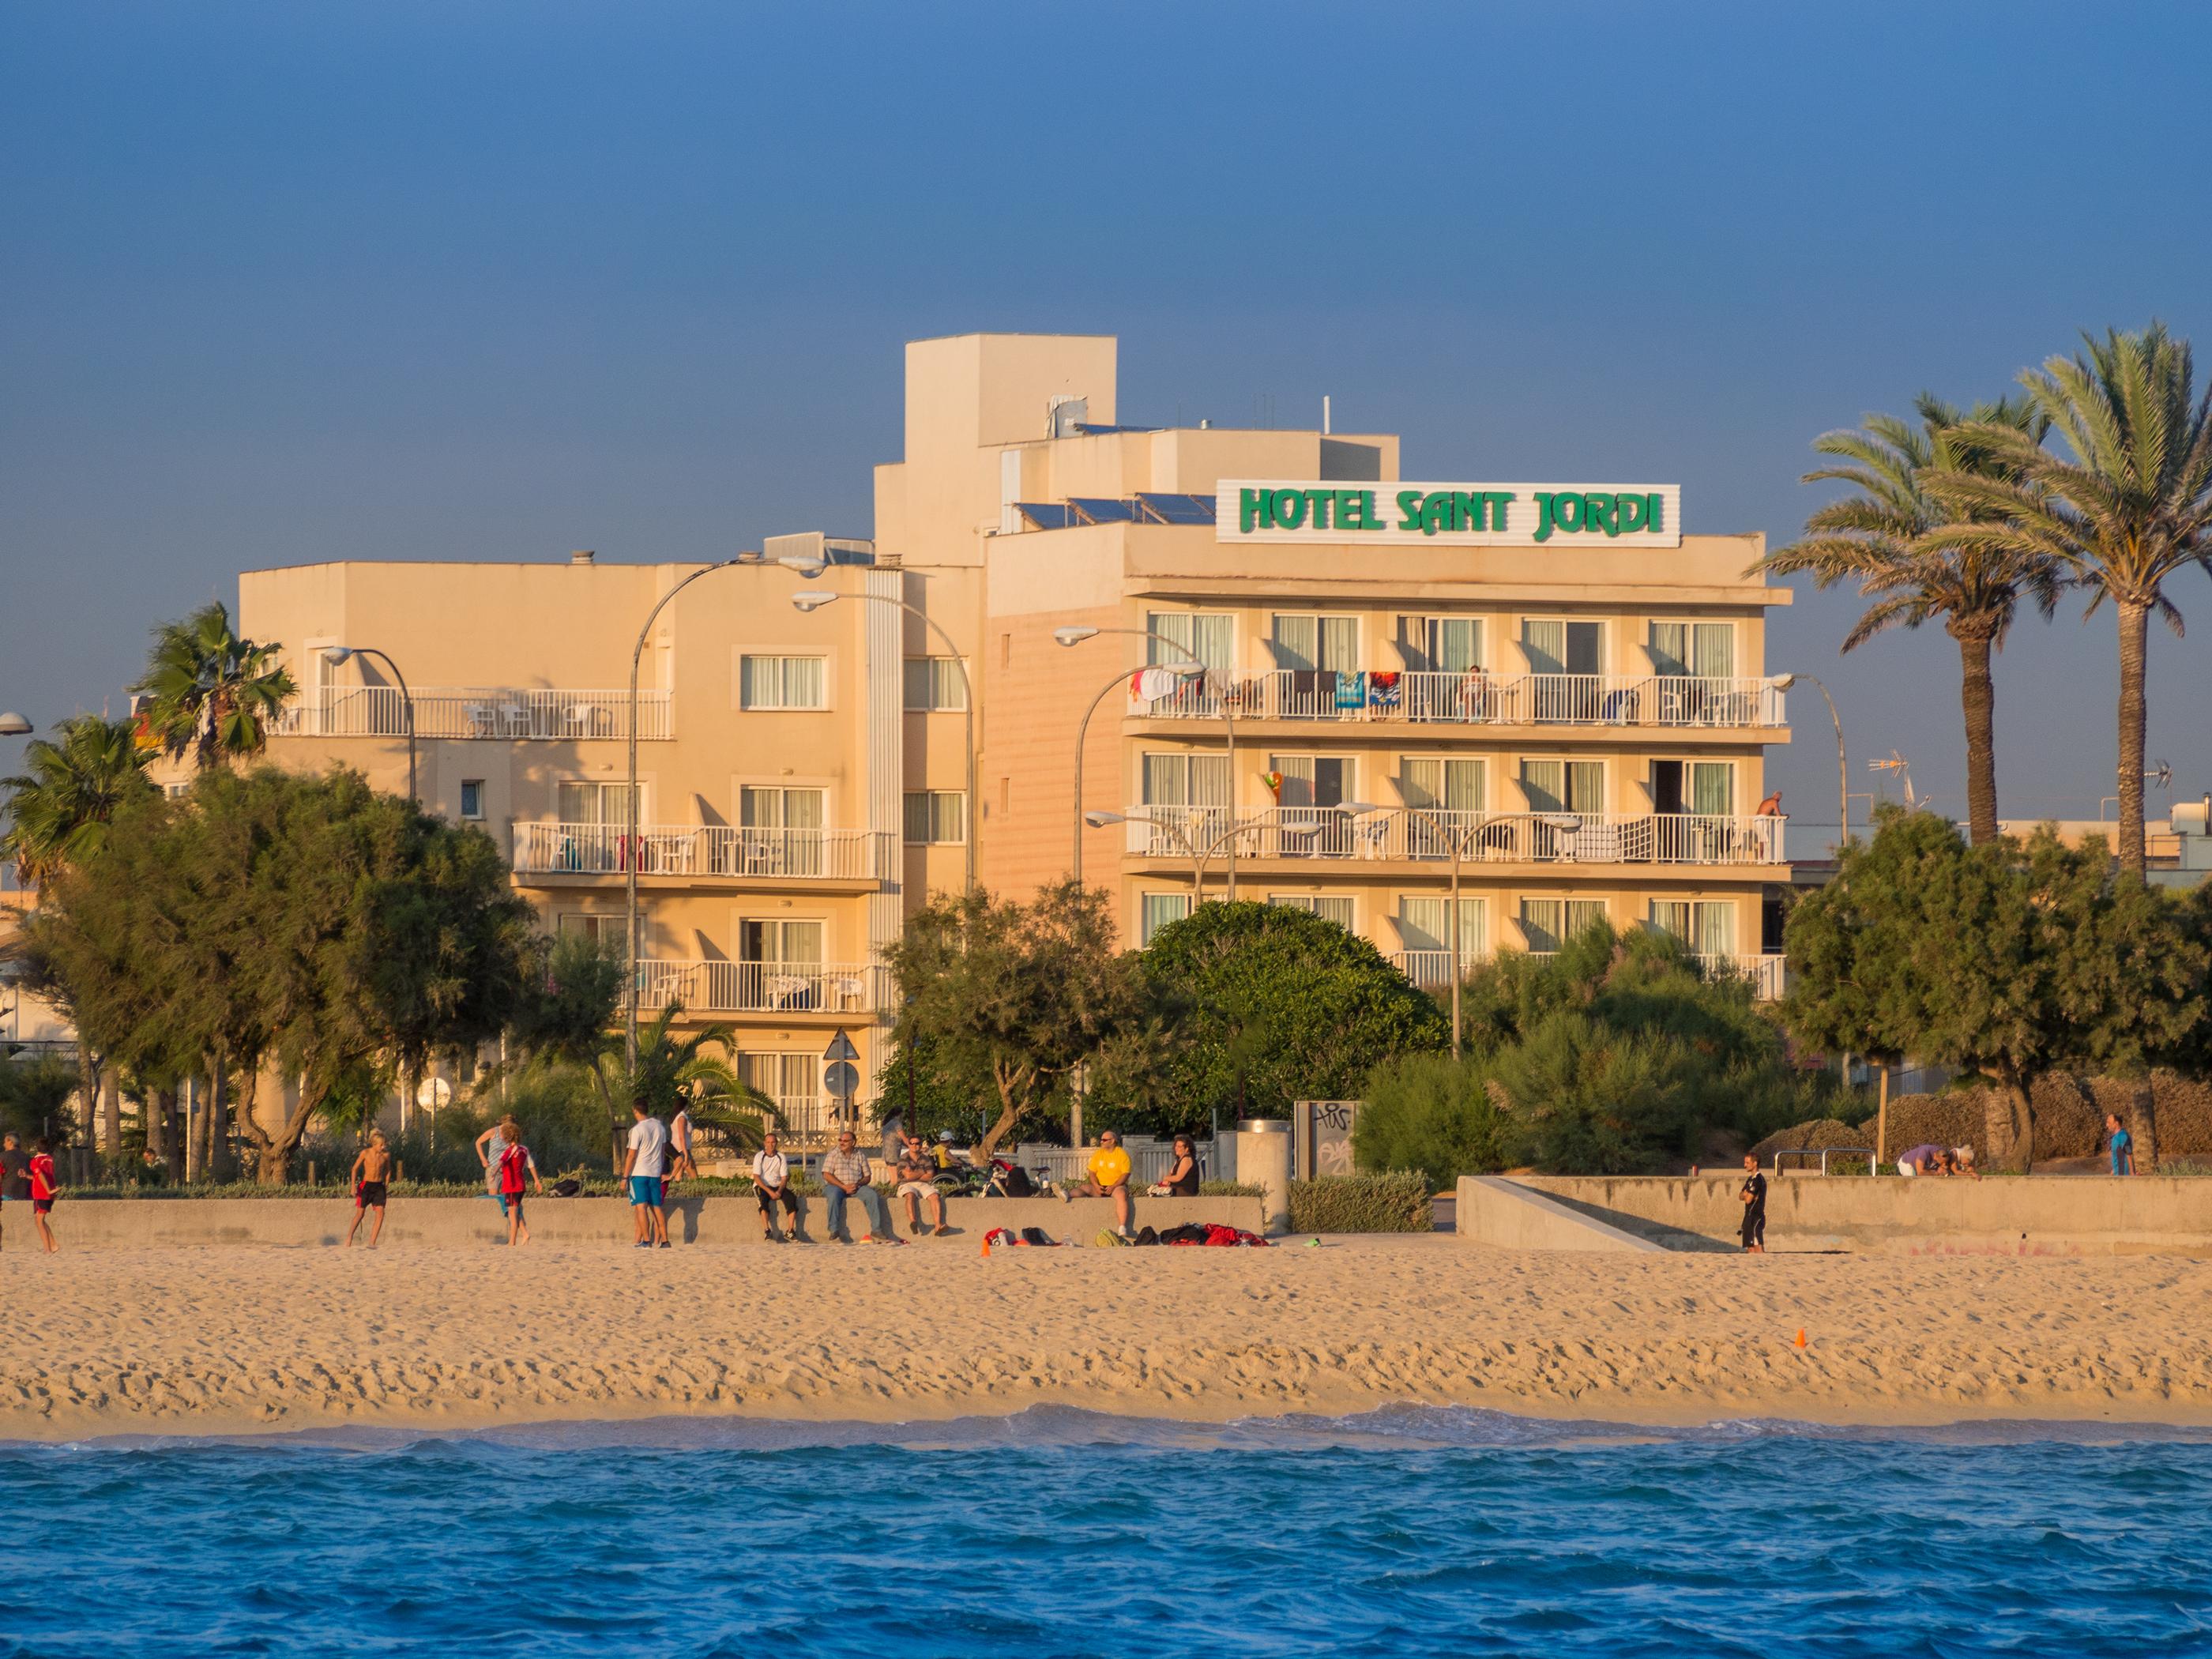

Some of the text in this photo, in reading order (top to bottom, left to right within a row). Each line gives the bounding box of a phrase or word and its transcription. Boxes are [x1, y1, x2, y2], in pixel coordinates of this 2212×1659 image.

[1240, 487, 1662, 543] HOTEL SANT JORDI
